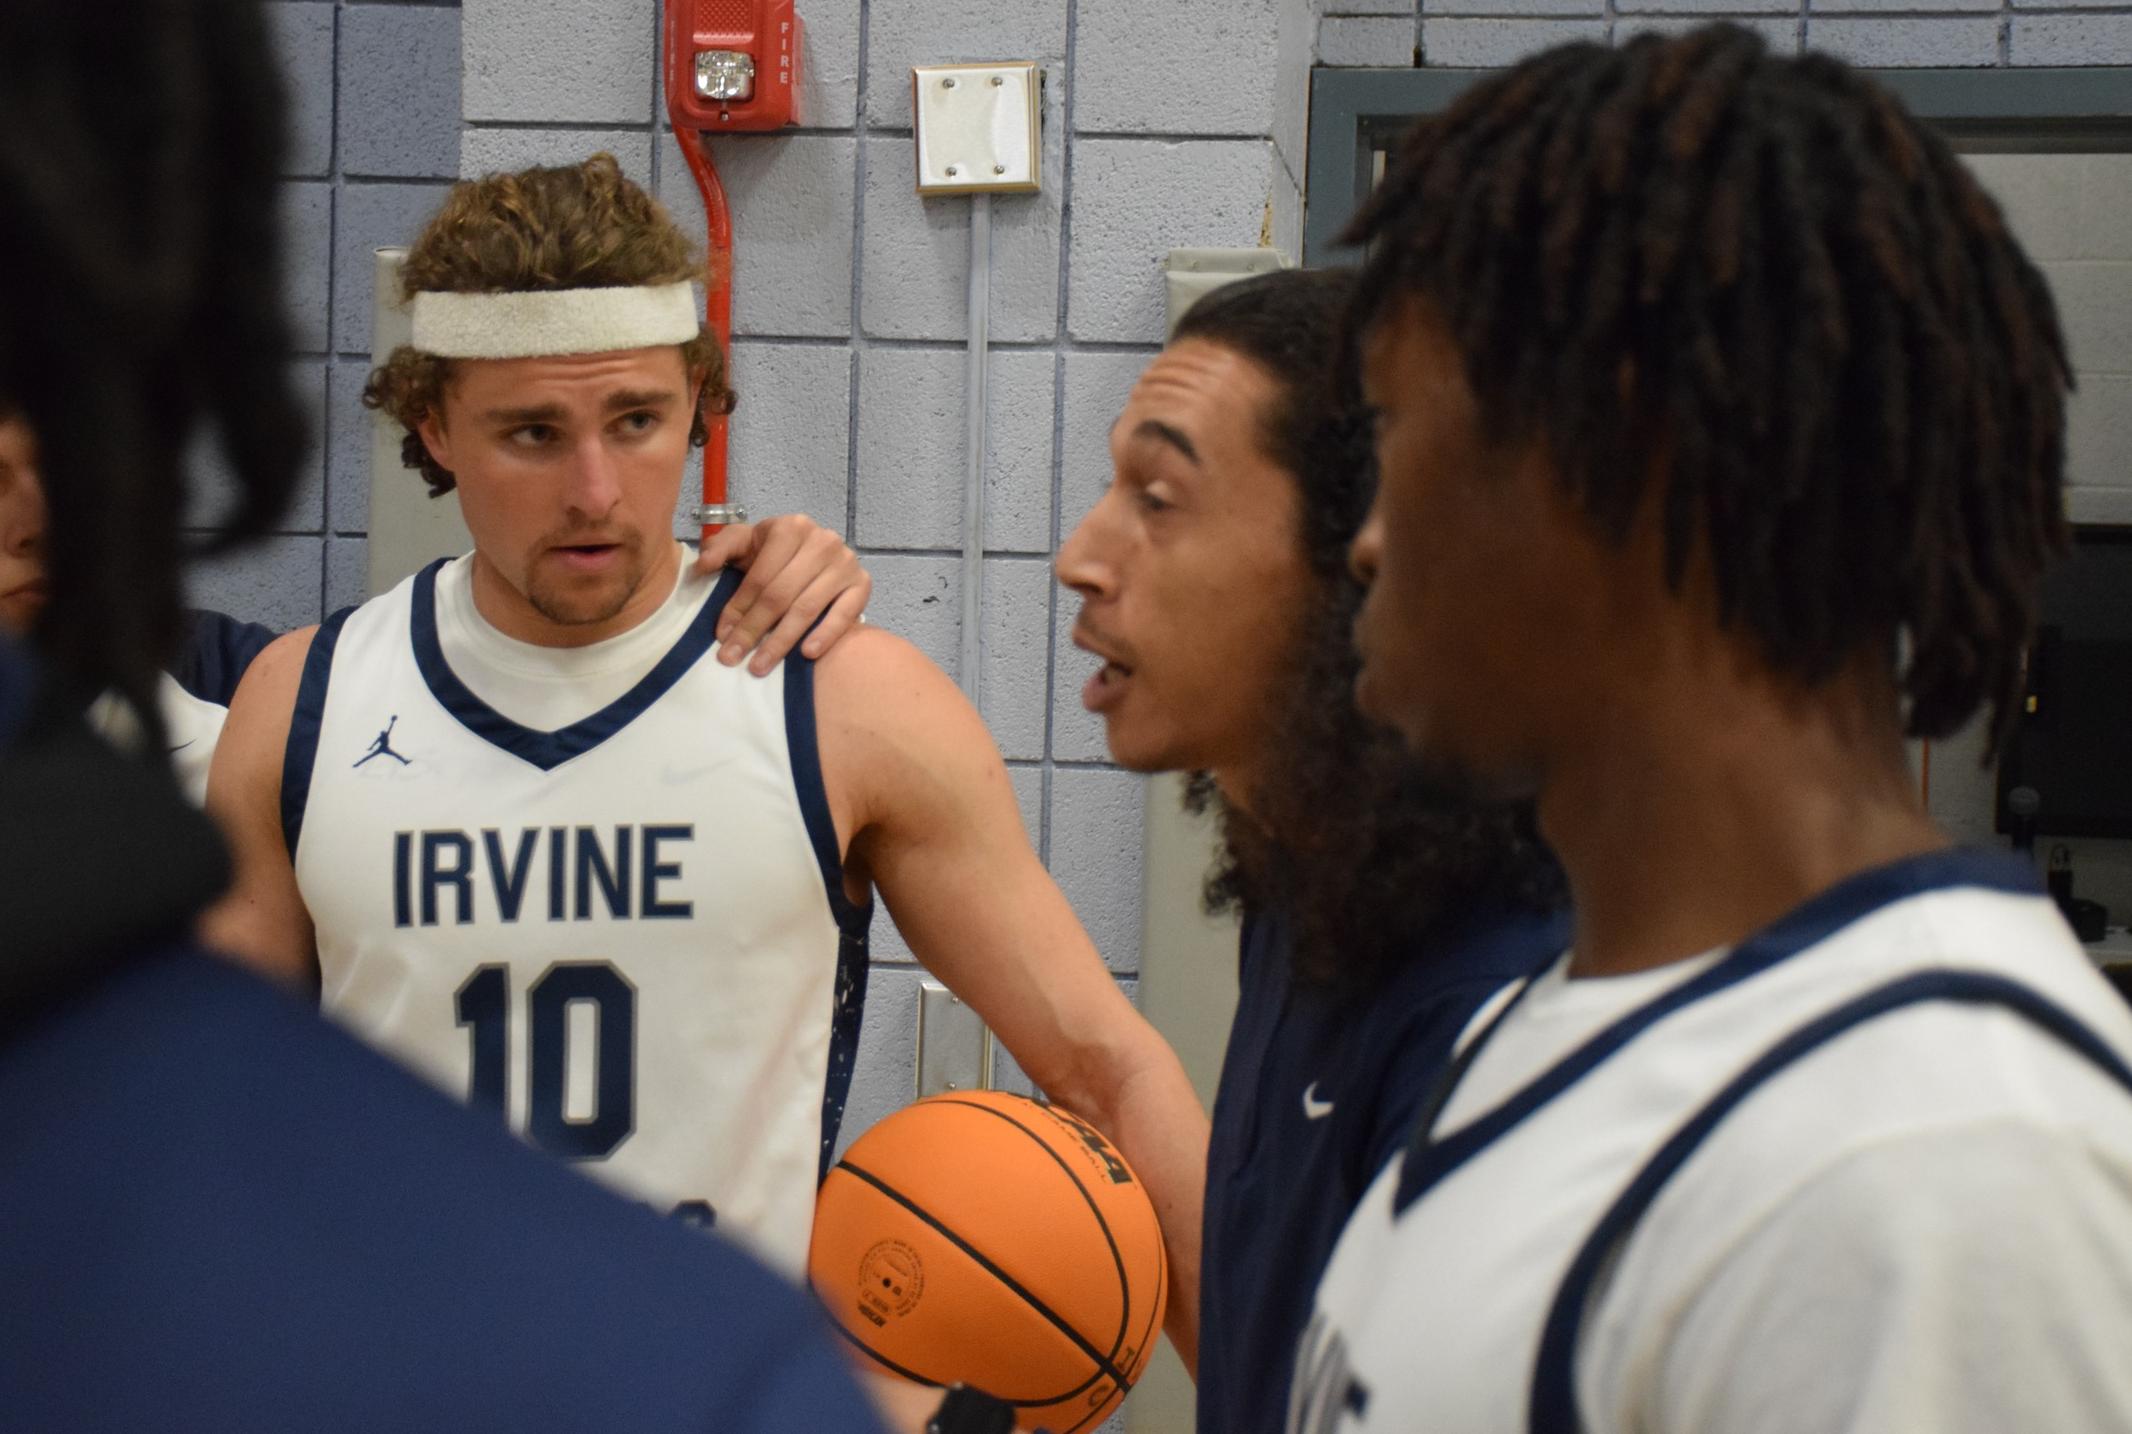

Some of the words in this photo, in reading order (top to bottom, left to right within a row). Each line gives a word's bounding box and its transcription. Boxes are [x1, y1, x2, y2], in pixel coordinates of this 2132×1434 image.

[780, 22, 789, 84] FIRE
[393, 824, 694, 928] IRVINE
[453, 960, 639, 1162] 10
